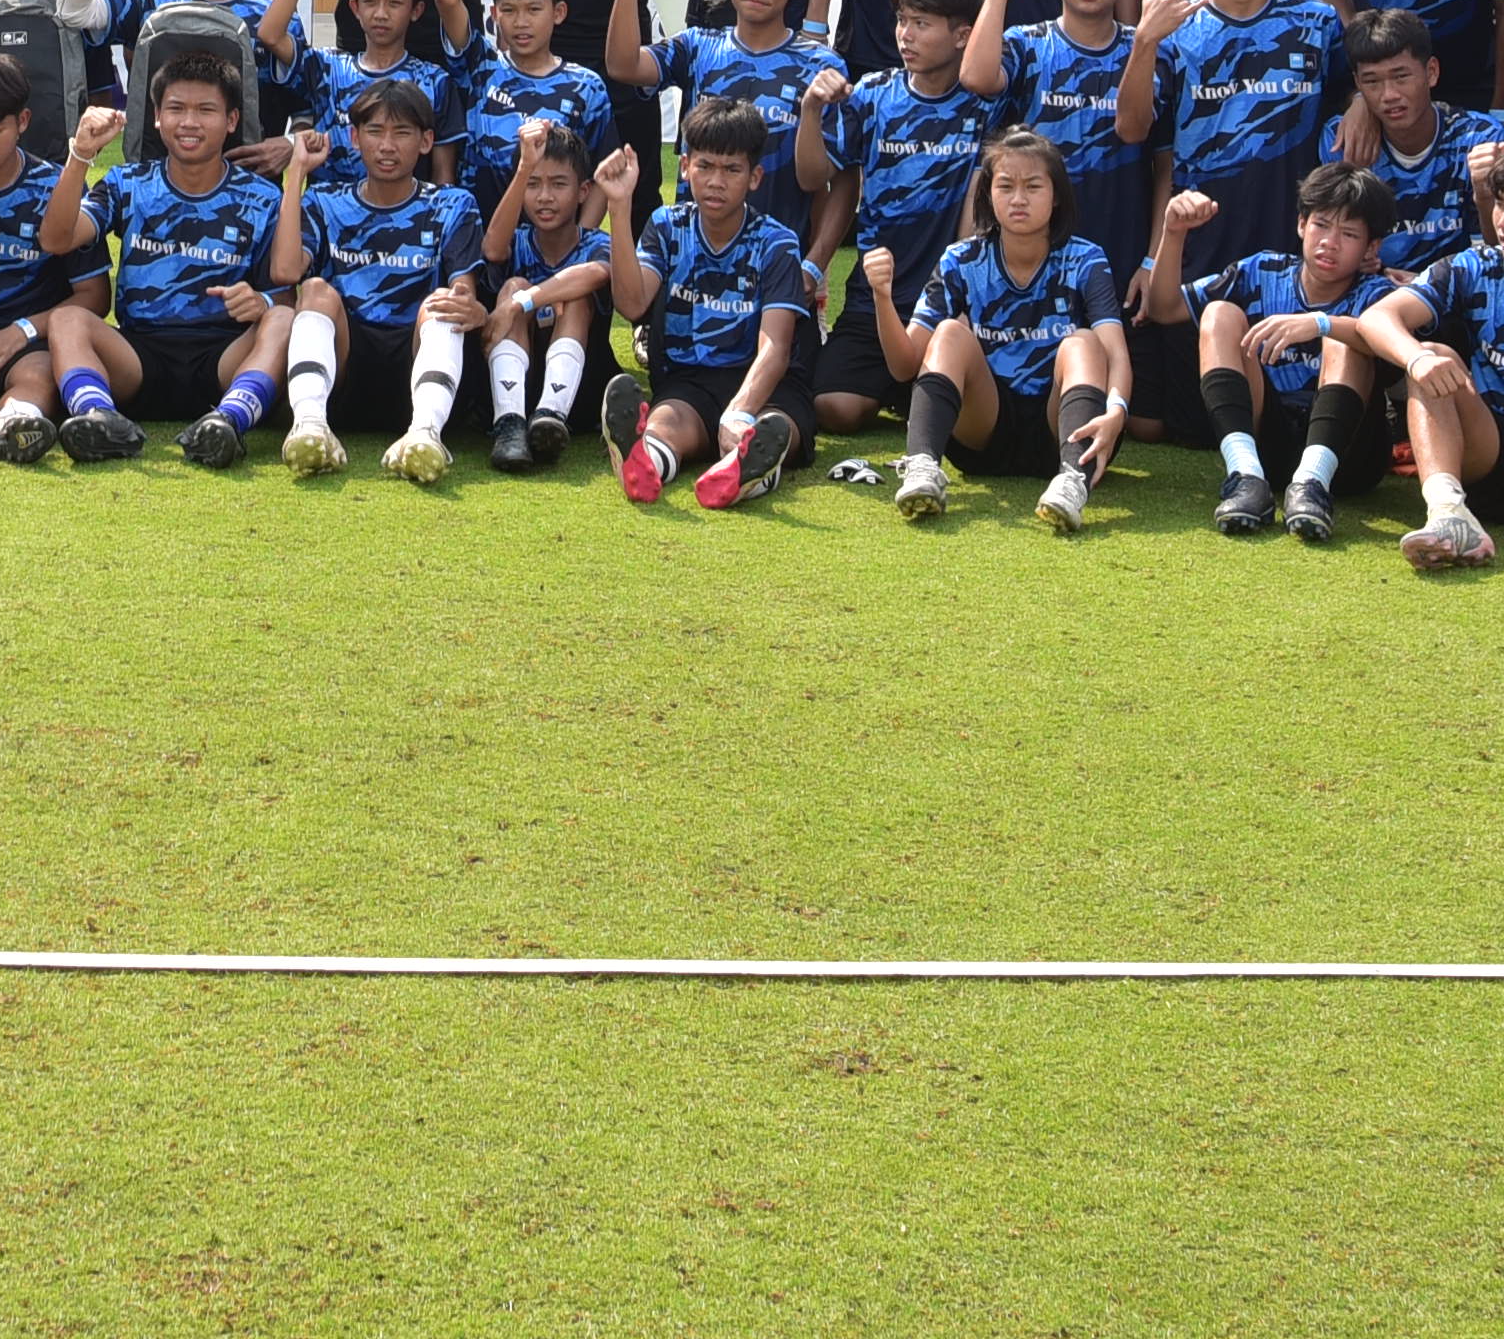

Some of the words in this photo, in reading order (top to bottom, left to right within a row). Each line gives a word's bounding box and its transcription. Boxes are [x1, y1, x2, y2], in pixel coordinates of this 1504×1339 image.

[487, 85, 517, 108] Kno
[1242, 78, 1279, 96] You
[1282, 78, 1313, 94] Can
[1040, 90, 1086, 108] Know
[1090, 94, 1117, 111] You
[878, 138, 919, 155] Know
[922, 140, 953, 157] You
[1404, 219, 1437, 236] You
[8, 241, 40, 261] Can
[130, 233, 176, 255] Know
[180, 241, 210, 260] You
[211, 247, 242, 265] Can
[329, 244, 373, 266] Know
[376, 250, 408, 268] You
[703, 294, 732, 313] You
[973, 322, 1017, 343] Know
[1020, 327, 1049, 341] You
